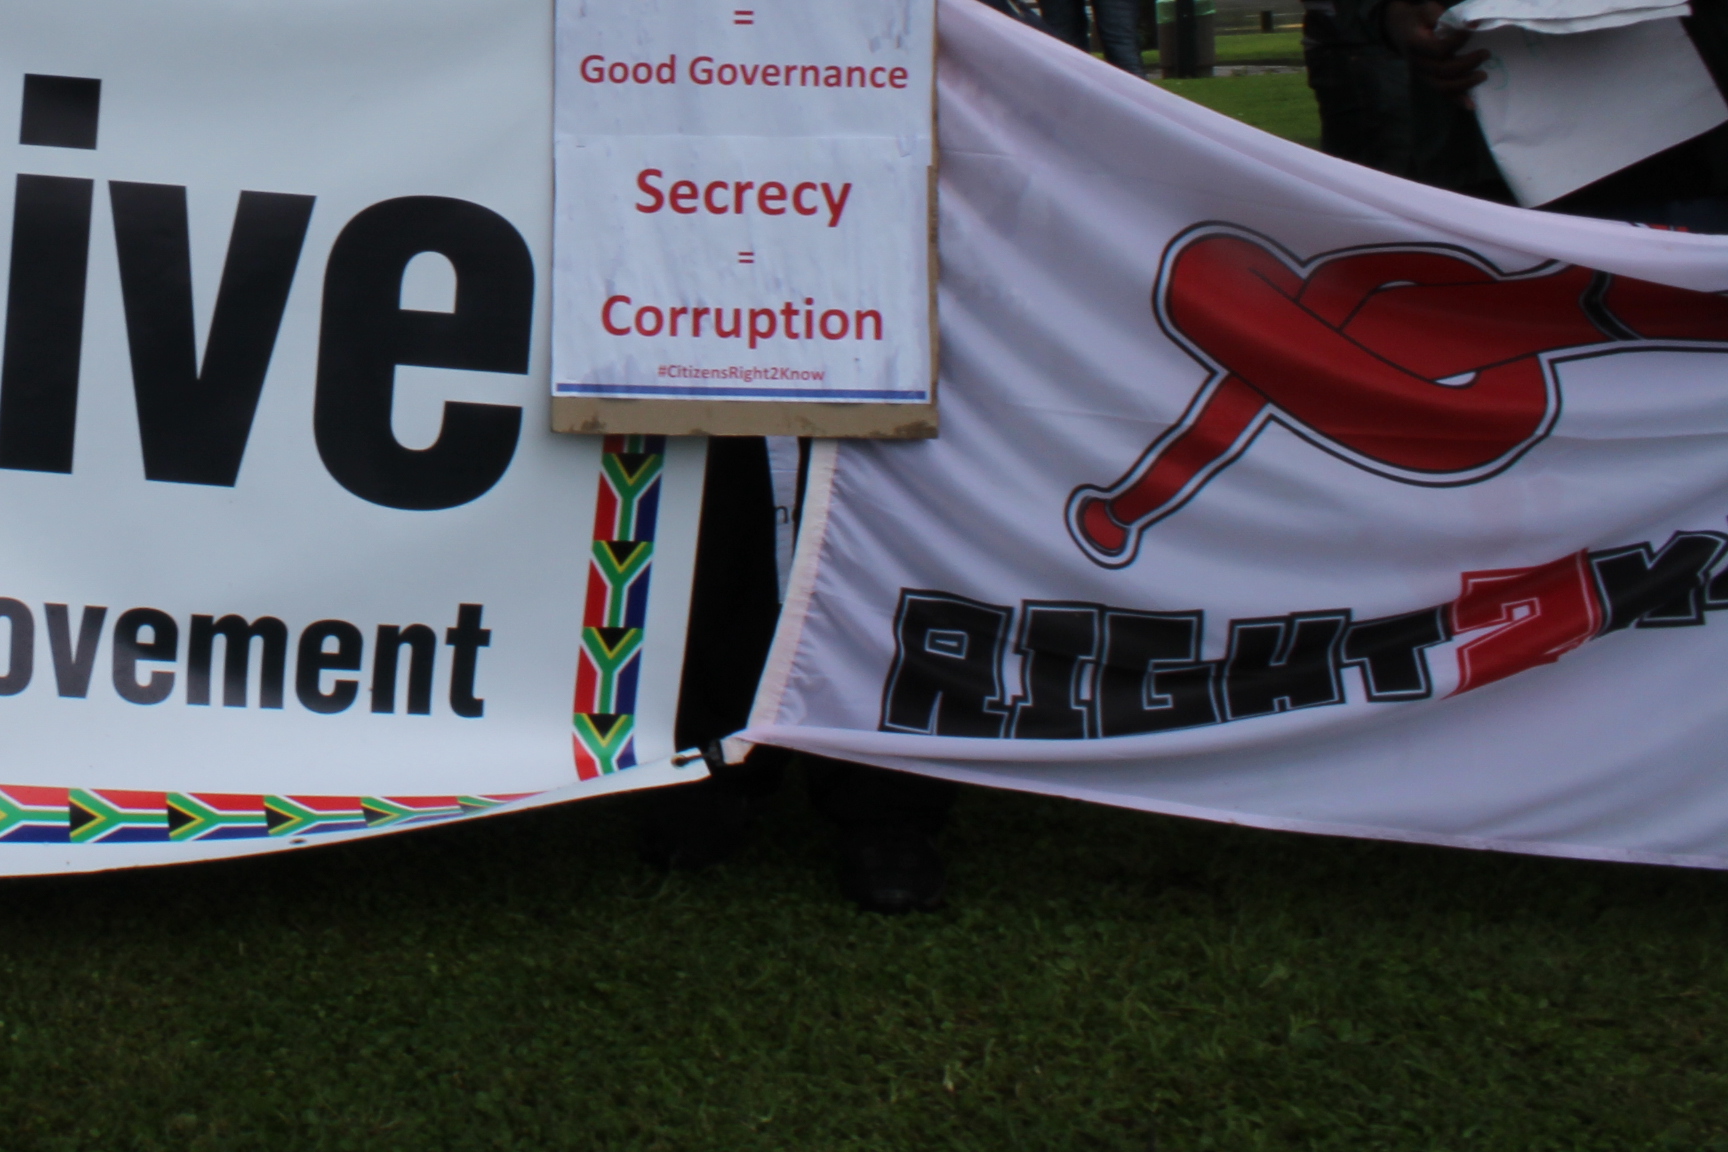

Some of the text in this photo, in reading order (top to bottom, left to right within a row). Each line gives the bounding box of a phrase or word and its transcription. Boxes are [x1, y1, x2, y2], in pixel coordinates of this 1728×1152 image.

[733, 10, 755, 25] =
[580, 53, 909, 89] Good Governance
[635, 168, 853, 228] Secrecy
[738, 251, 755, 264] =
[601, 294, 883, 350] Corruption
[657, 364, 826, 383] #CitizensRight2Know
[878, 516, 1728, 741] RIGHT2K
